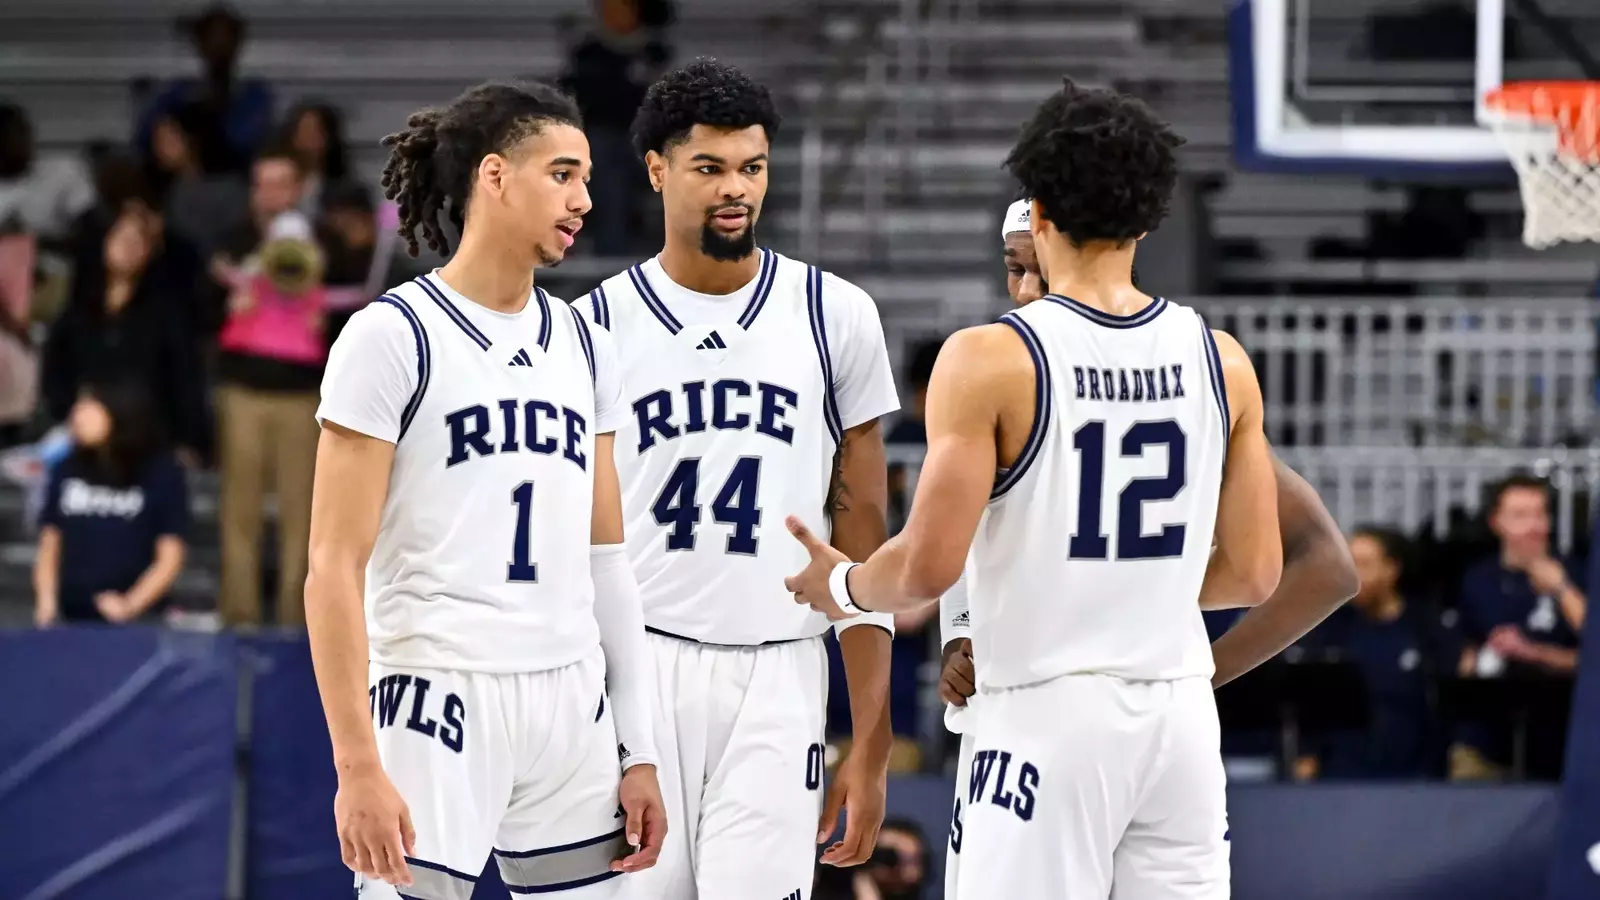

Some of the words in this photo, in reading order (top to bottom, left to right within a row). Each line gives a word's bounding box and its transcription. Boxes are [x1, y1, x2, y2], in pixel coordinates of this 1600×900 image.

[631, 379, 798, 456] RICE
[1073, 365, 1185, 402] BROADNAX
[444, 398, 587, 472] RICE
[649, 455, 762, 557] 44
[1067, 418, 1188, 561] 12
[506, 479, 538, 583] 1
[968, 749, 1040, 822] WLS
